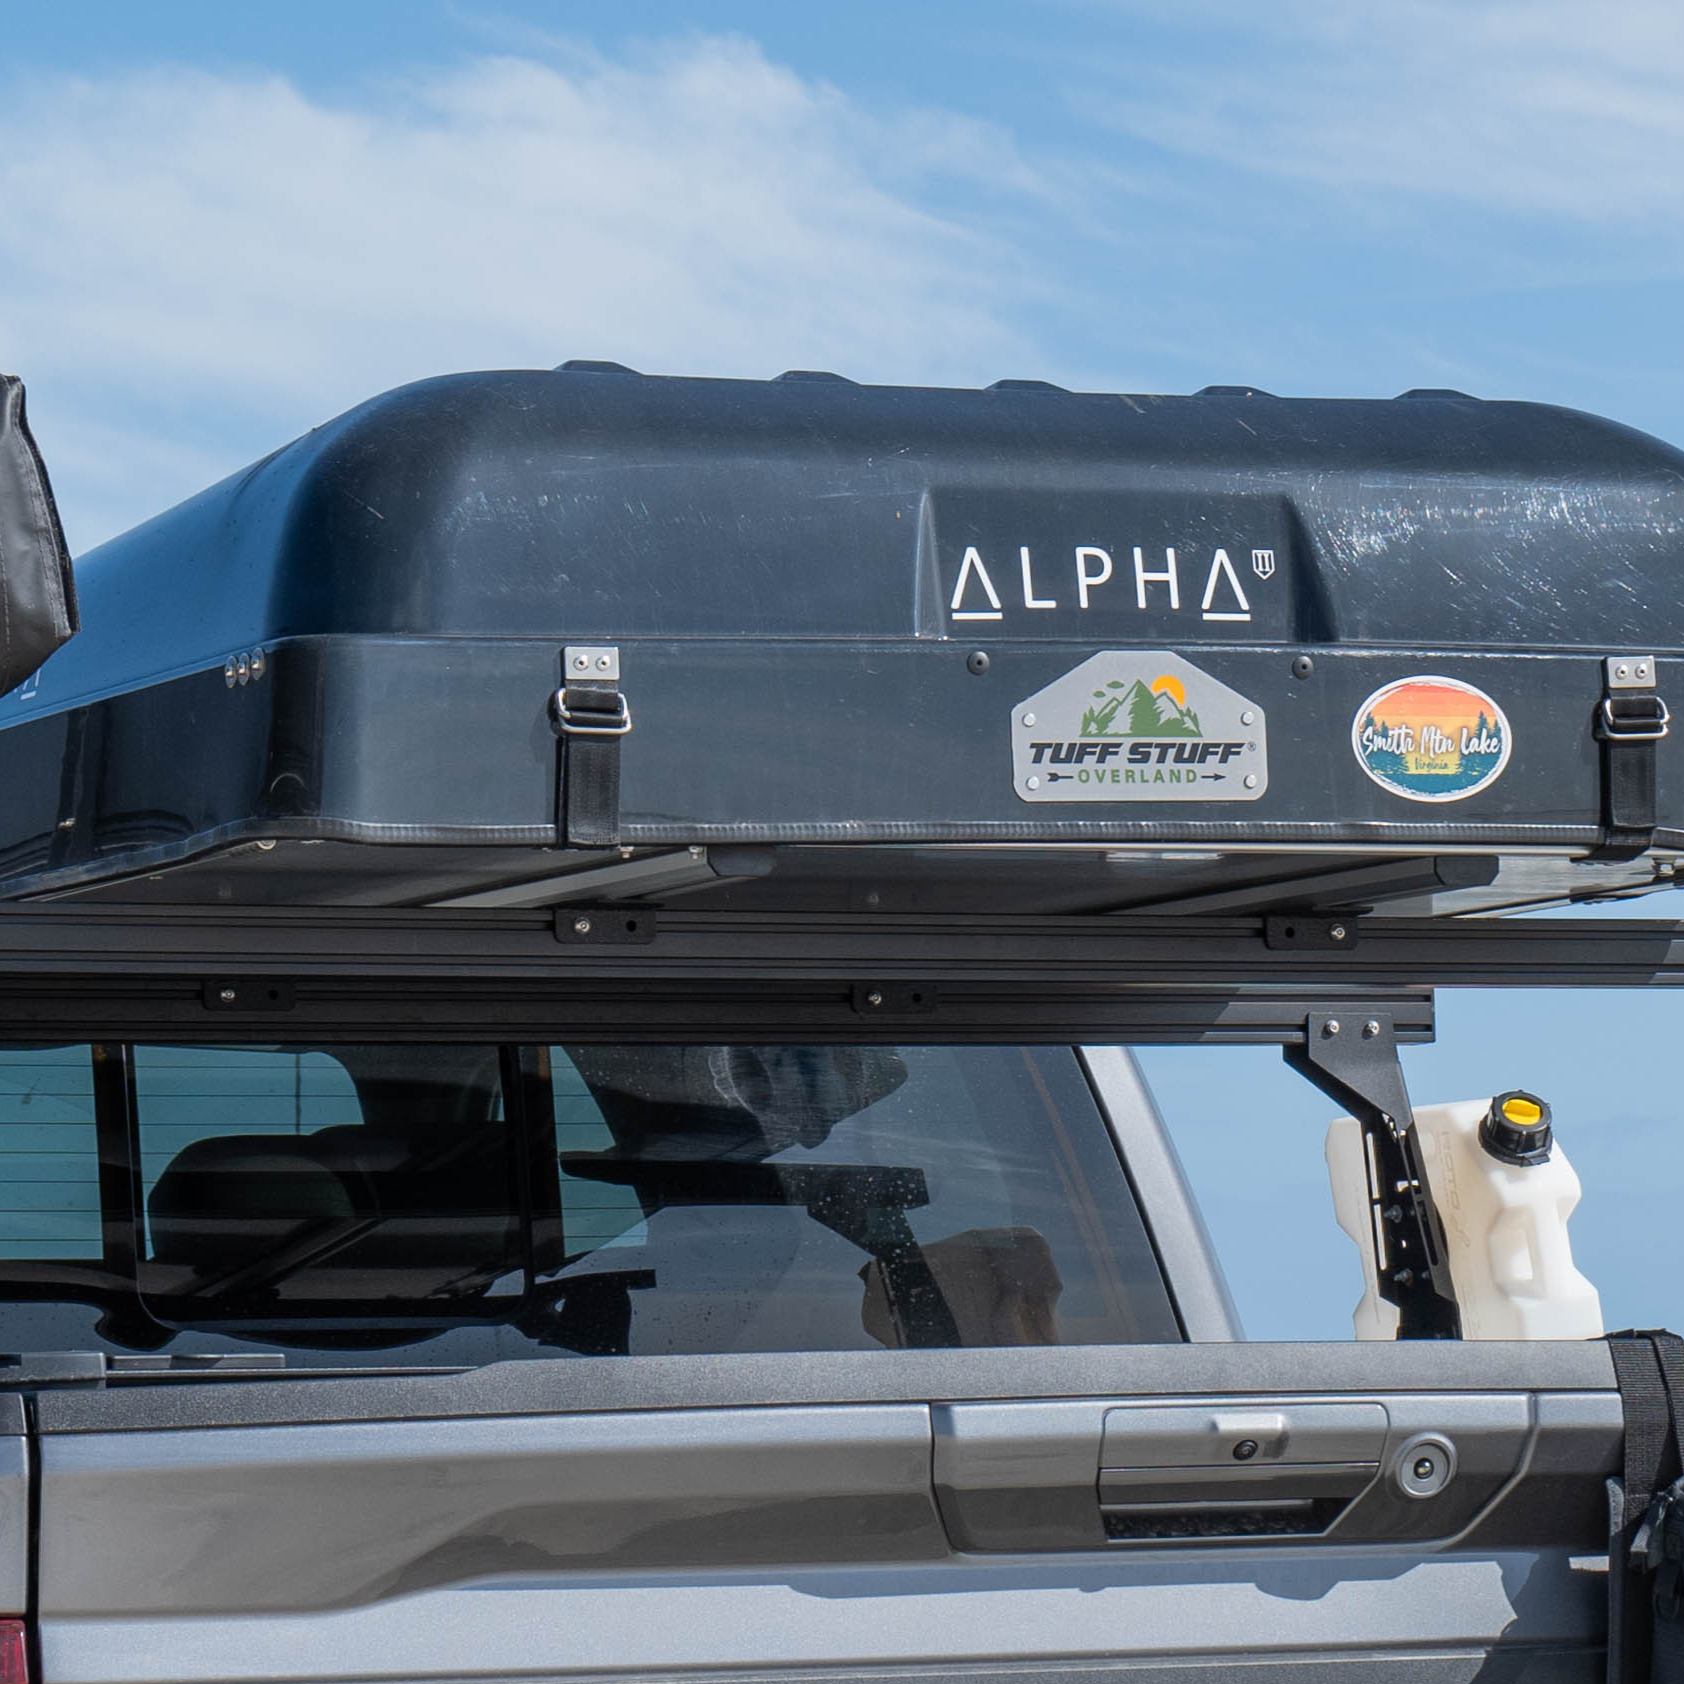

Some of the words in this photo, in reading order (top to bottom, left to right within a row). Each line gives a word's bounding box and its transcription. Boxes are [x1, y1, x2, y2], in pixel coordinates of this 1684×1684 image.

[951, 546, 1251, 621] ALPHA
[1362, 723, 1416, 756] Smith
[1420, 725, 1456, 759] Mtn
[1460, 727, 1501, 756] Lake
[1029, 742, 1124, 765] TUFF
[1414, 756, 1450, 772] Virginia
[1077, 768, 1198, 784] OVERLAND
